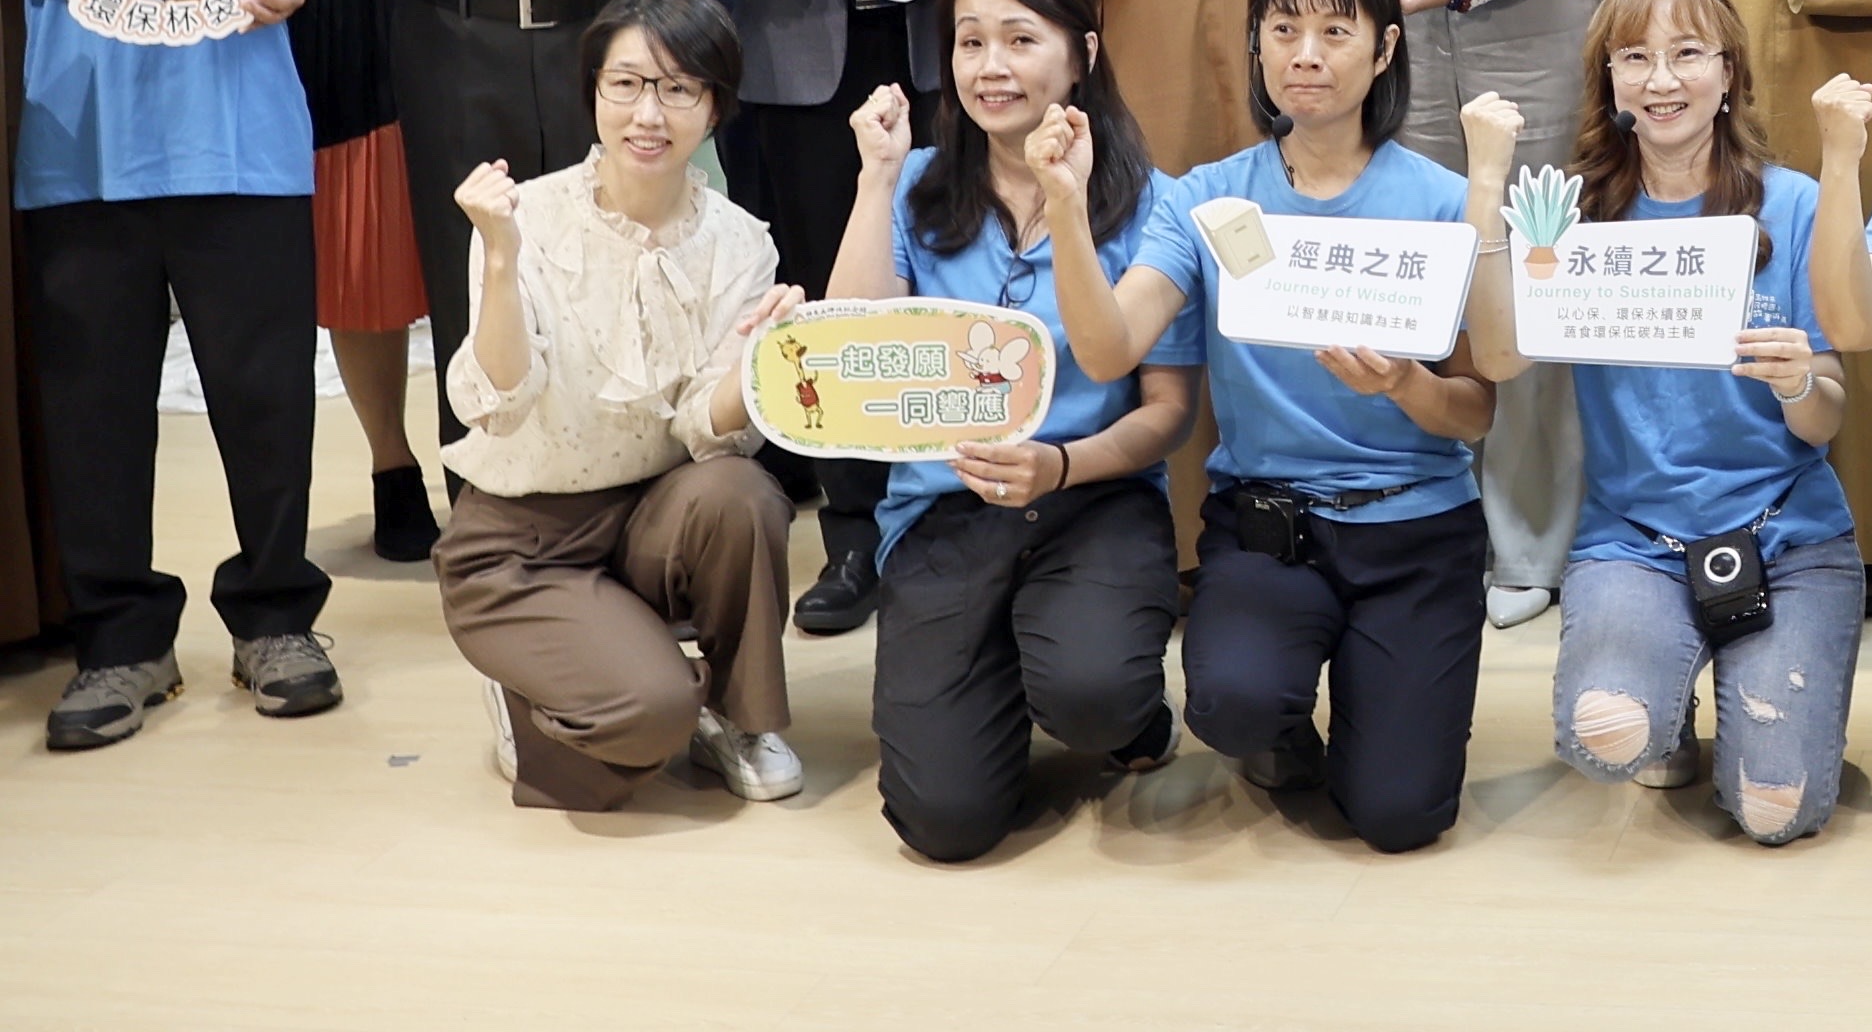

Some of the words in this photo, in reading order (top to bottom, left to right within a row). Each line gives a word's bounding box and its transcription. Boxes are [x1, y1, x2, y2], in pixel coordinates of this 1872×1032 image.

[1289, 239, 1428, 281] 經典之旅
[1567, 245, 1706, 277] 永續之旅
[1265, 278, 1330, 299] Journey
[1335, 285, 1352, 299] of
[1357, 287, 1424, 306] Wisdom
[1527, 285, 1592, 301] Journey
[1598, 285, 1613, 298] to
[1619, 284, 1736, 301] Sustainability
[1287, 304, 1418, 331] 以智慧與知識為主軸
[1557, 307, 1704, 321] 以心保、環保永續發展
[1563, 325, 1697, 339] 蔬食環保低碳為主軸
[806, 344, 947, 378] 一起發願
[865, 388, 1006, 424] 一同響應
